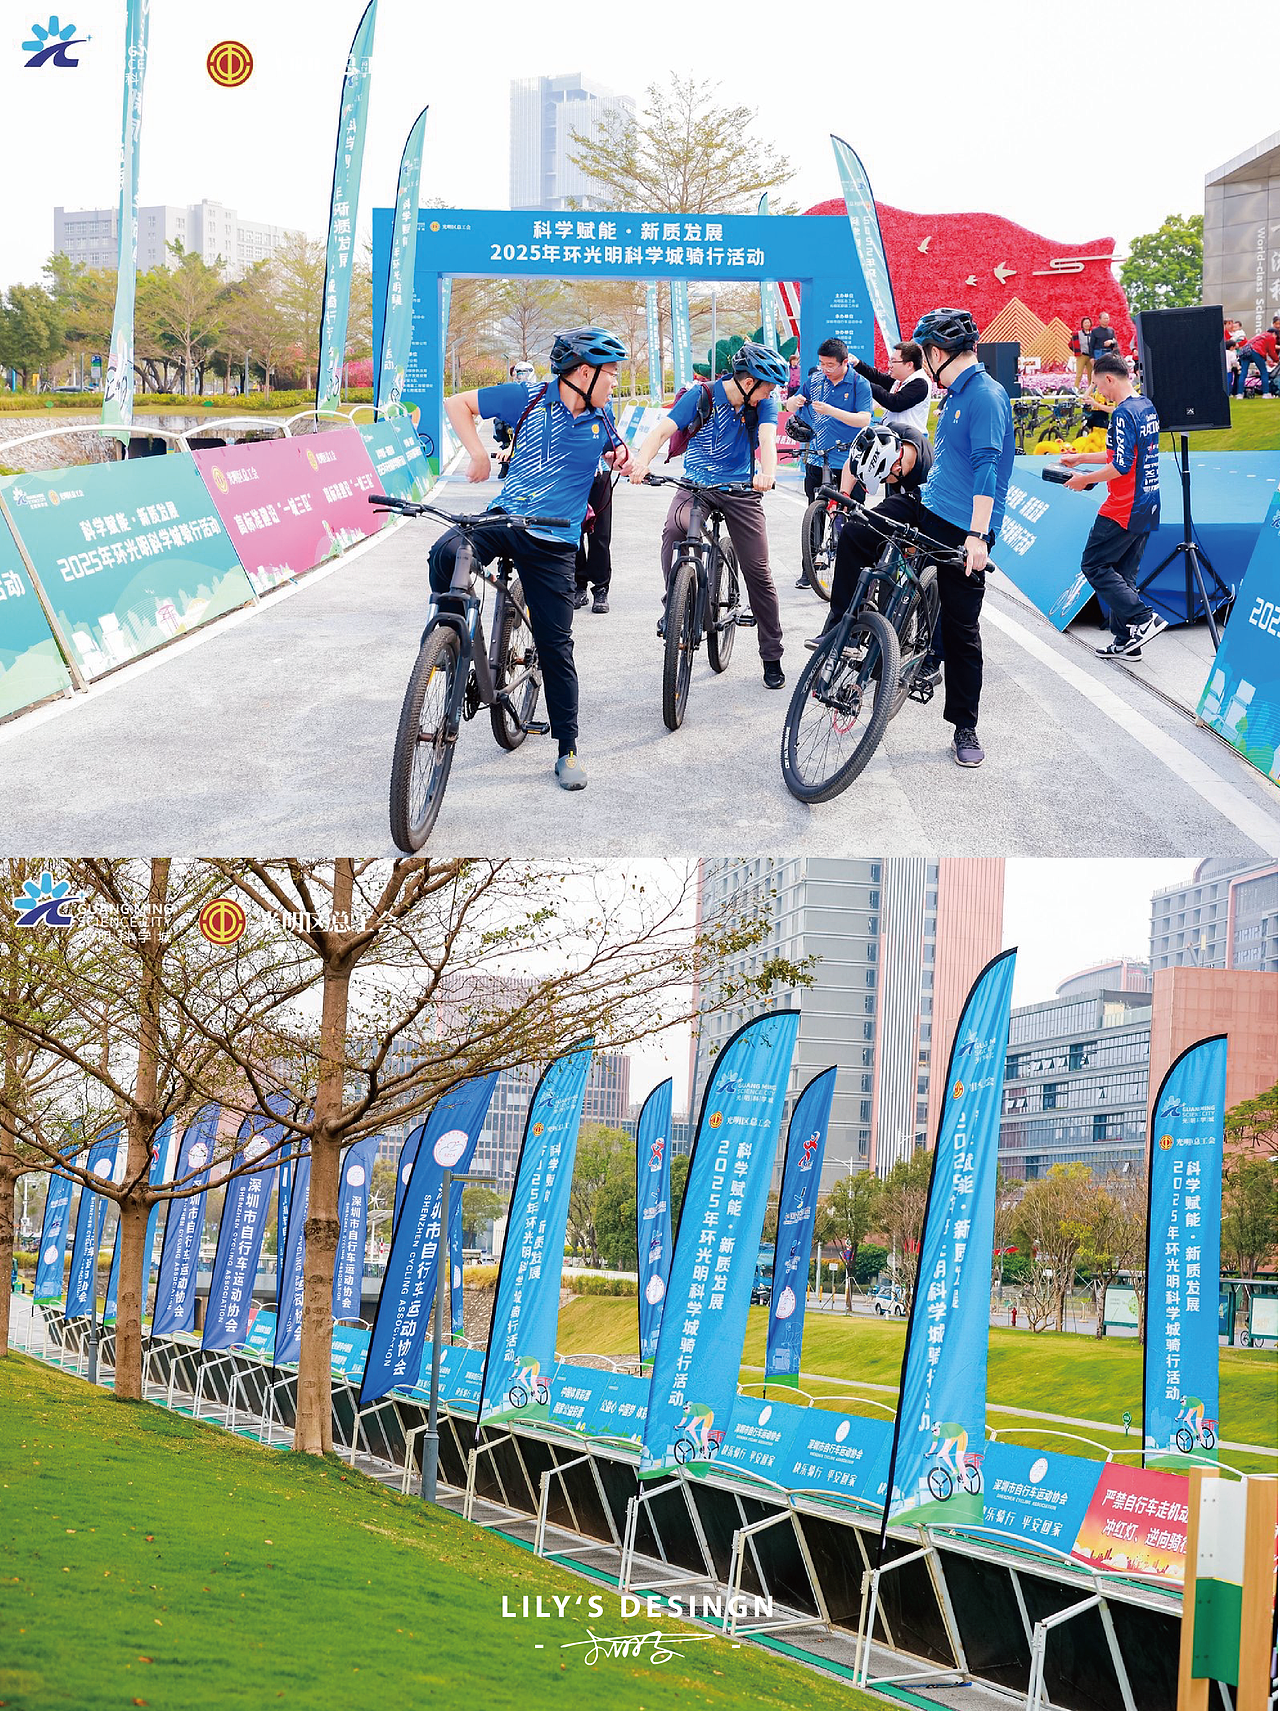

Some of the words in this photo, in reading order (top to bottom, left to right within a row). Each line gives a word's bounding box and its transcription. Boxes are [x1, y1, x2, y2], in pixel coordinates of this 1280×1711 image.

[533, 220, 723, 242] 科学赋能·新质发展
[490, 244, 765, 266] 2025年环光明科学城骑行活动
[1255, 298, 1265, 335] Scienc
[79, 501, 180, 542] 科学赋能·新质发展
[56, 515, 222, 582] 2025年环光明科学城骑行活动
[1248, 597, 1280, 639] 202
[413, 1194, 432, 1247] SHENZHEN
[707, 1142, 753, 1310] 科学赋能·新质发展
[1184, 1161, 1202, 1312] 科学赋能·新质发展
[225, 1178, 263, 1333] 深圳市自行车运动协会
[342, 1195, 362, 1309] 深圳市自行车运动协会
[401, 1251, 416, 1295] CYCLING
[668, 1140, 730, 1407] 2025年环光明科学城骑行活动
[1165, 1161, 1184, 1401] 2025年环光明科学城骑行活动
[734, 1423, 782, 1443] 深圳市自行车运动协会
[807, 1438, 864, 1460] 深圳市自行车运动协会
[792, 1462, 824, 1479] 快乐骑行
[827, 1469, 858, 1488] 平安回家
[992, 1478, 1068, 1506] 深圳市自行车运动协会
[1021, 1514, 1064, 1537] 平安回家
